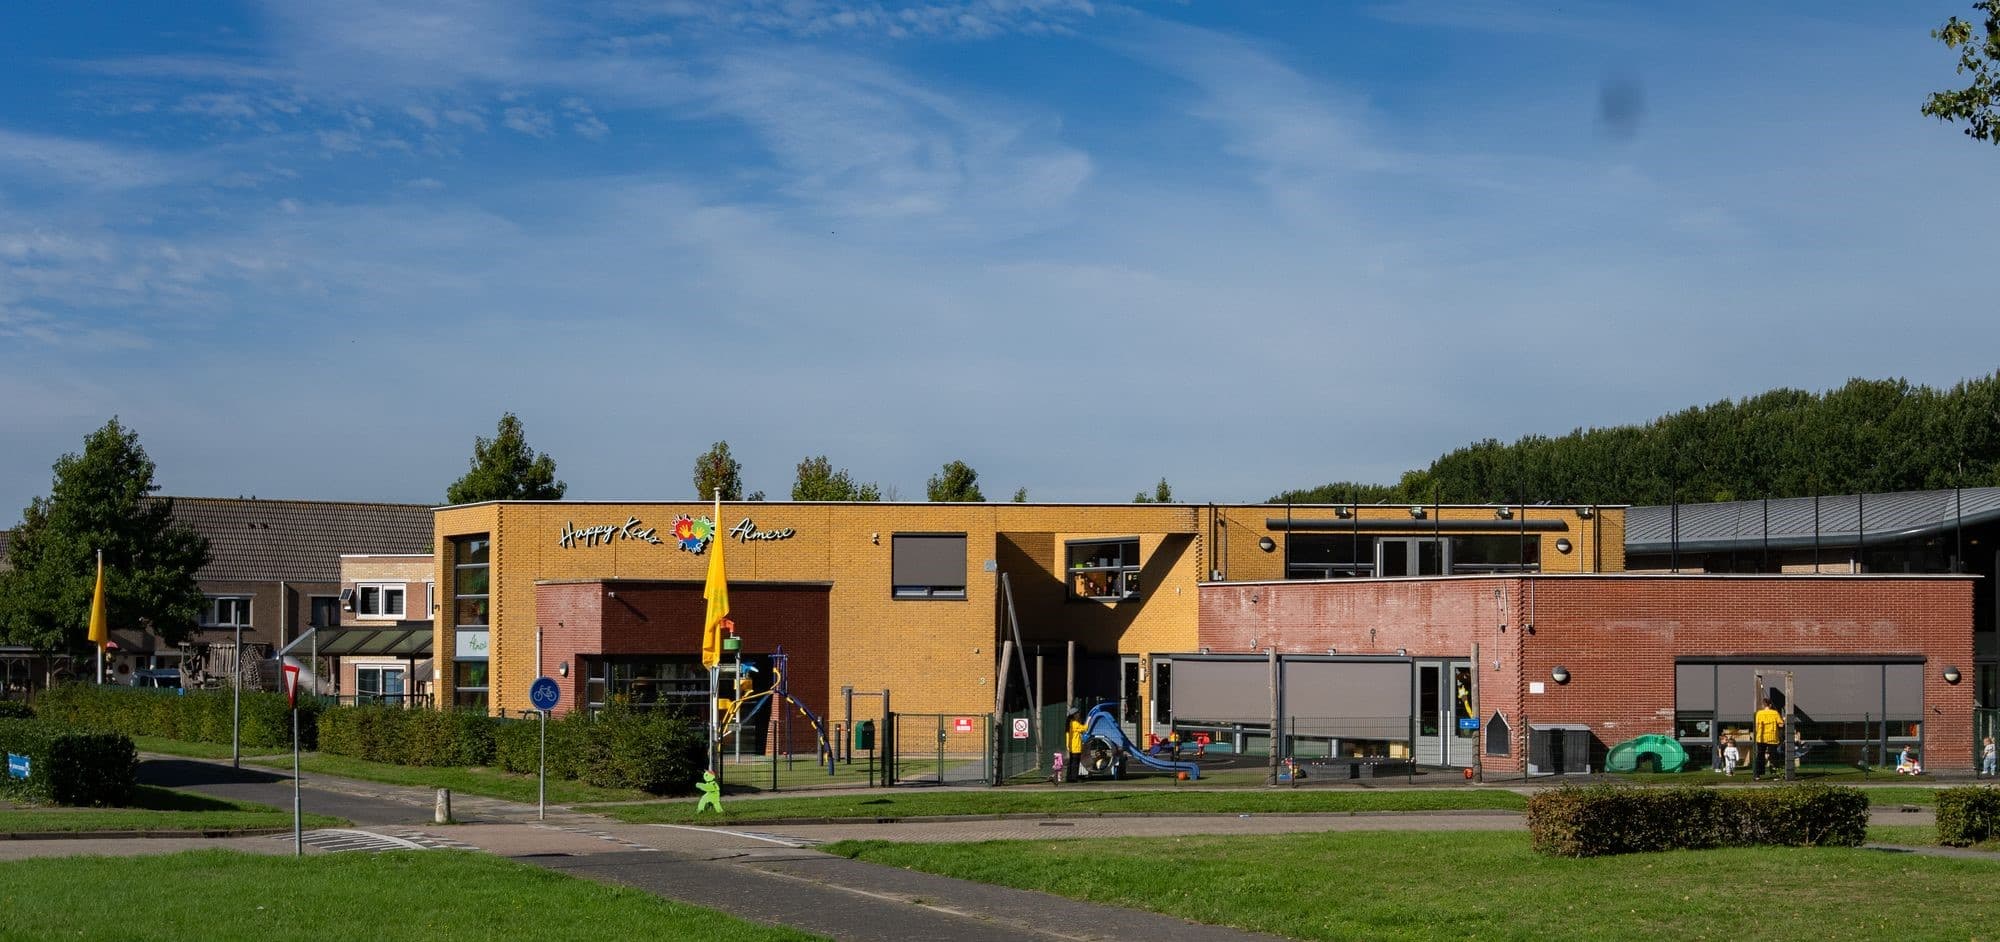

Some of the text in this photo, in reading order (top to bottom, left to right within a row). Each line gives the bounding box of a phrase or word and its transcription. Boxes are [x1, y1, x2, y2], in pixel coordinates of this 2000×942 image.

[559, 516, 795, 548] Happy Kids Almere
